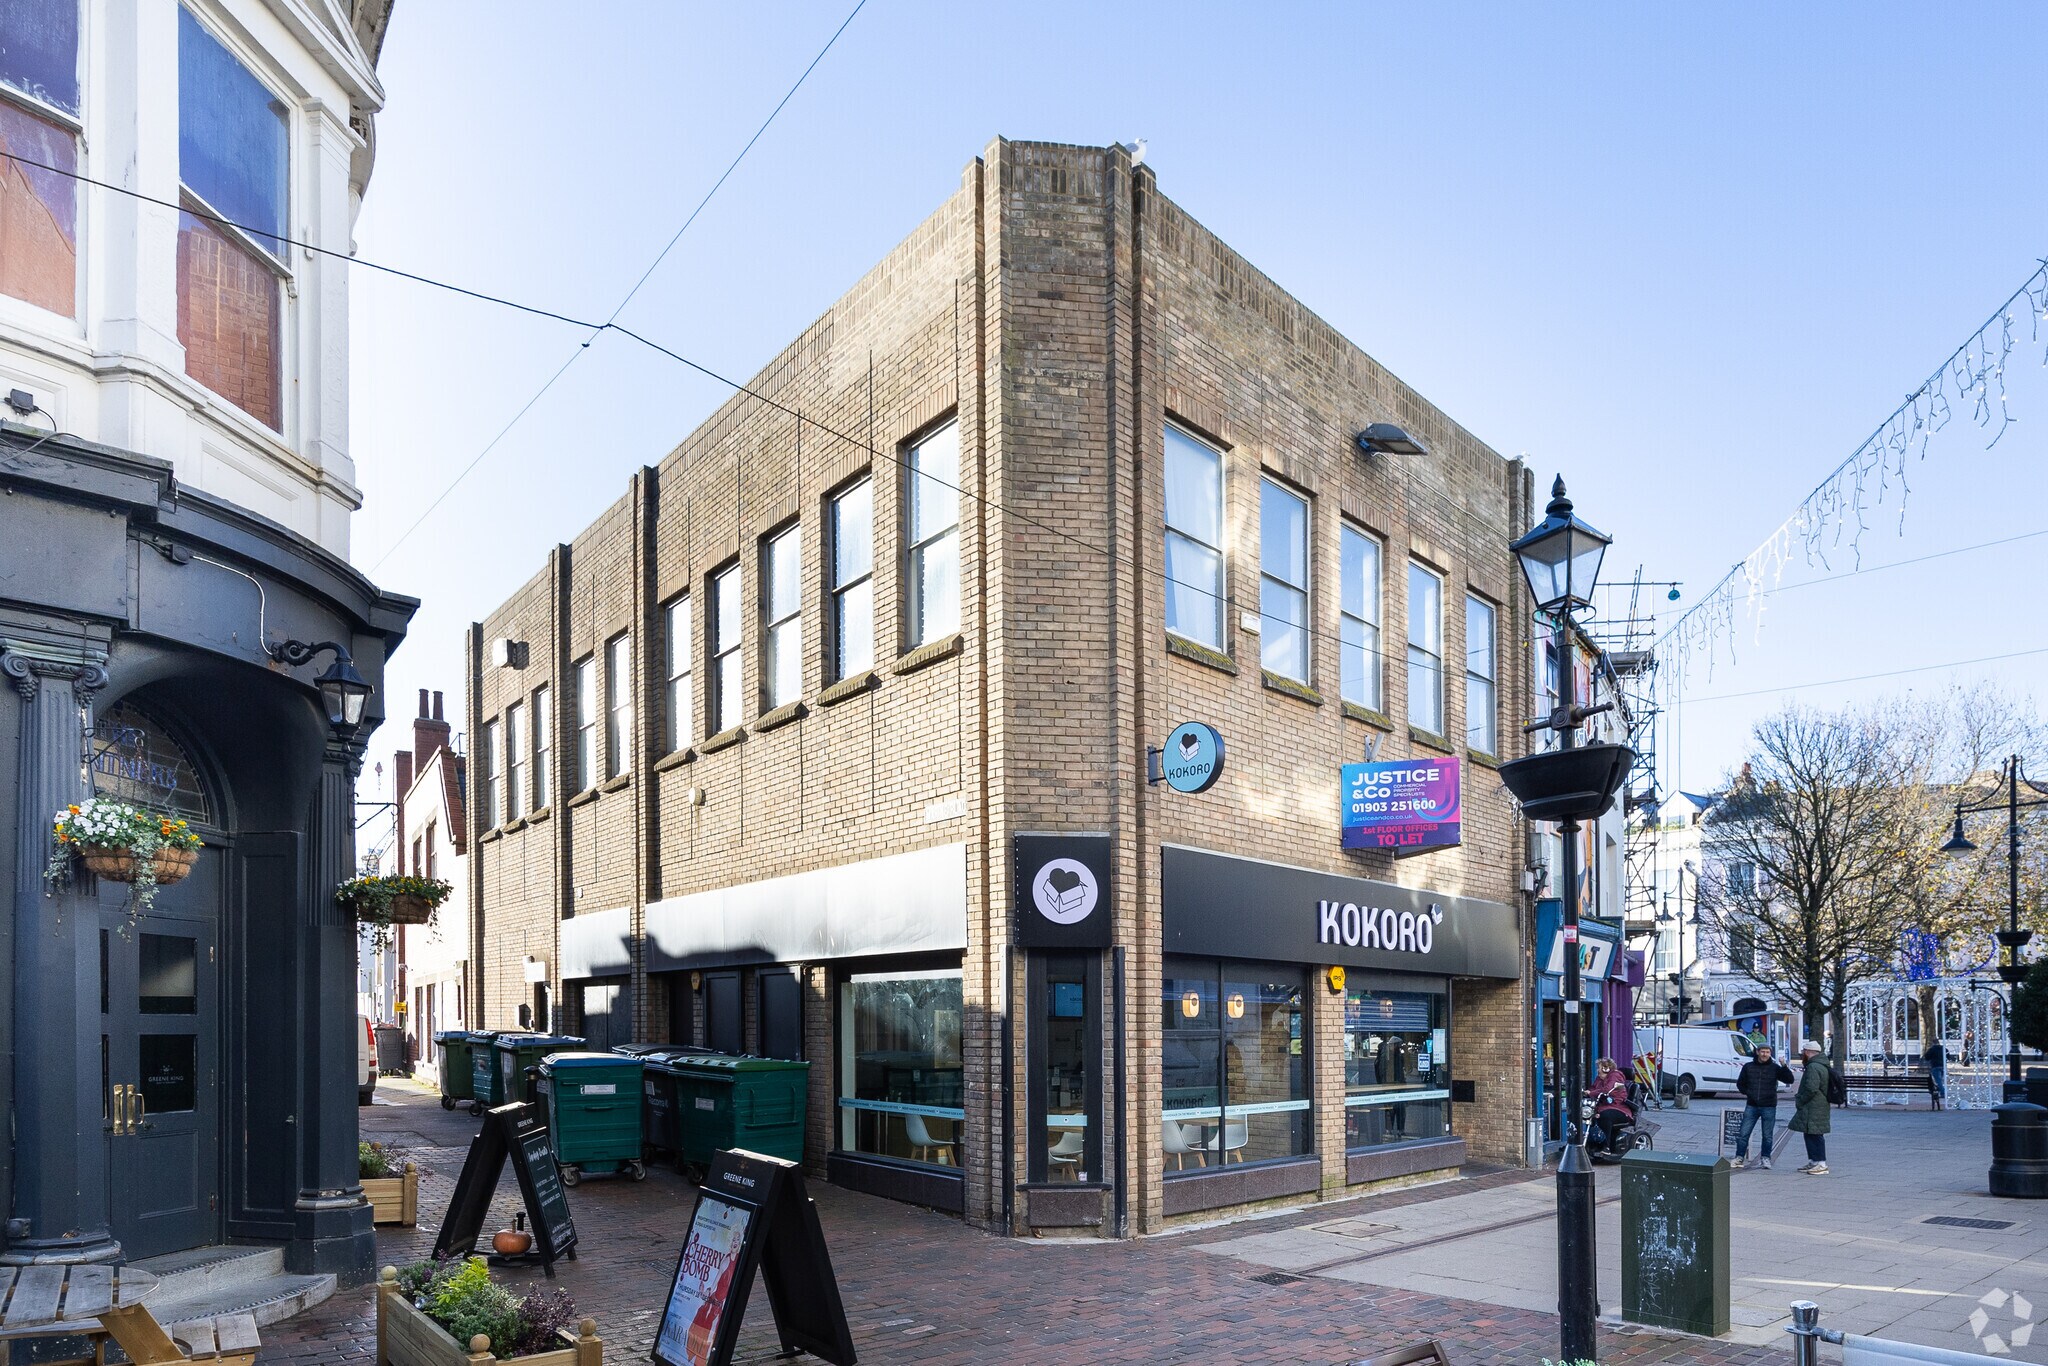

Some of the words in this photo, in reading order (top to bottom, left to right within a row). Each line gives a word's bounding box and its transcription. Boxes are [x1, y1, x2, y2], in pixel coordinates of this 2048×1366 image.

[1168, 762, 1211, 779] KOKORO
[1352, 768, 1440, 786] JUSTICE
[1352, 801, 1388, 813] 01903
[1391, 799, 1436, 811] 251600
[1352, 814, 1413, 822] justiceandco.co.uk
[1363, 826, 1376, 834] 1st
[1377, 825, 1404, 833] FLOOR
[1405, 823, 1439, 831] OFFICES
[1377, 834, 1396, 845] TO
[1400, 832, 1425, 844] LET
[1319, 900, 1433, 954] KOKORO
[1167, 1098, 1203, 1109] KOKORO
[723, 1172, 742, 1184] GREENE
[741, 1176, 755, 1187] KING
[688, 1241, 725, 1269] CHERRY
[682, 1258, 710, 1282] BOMB
